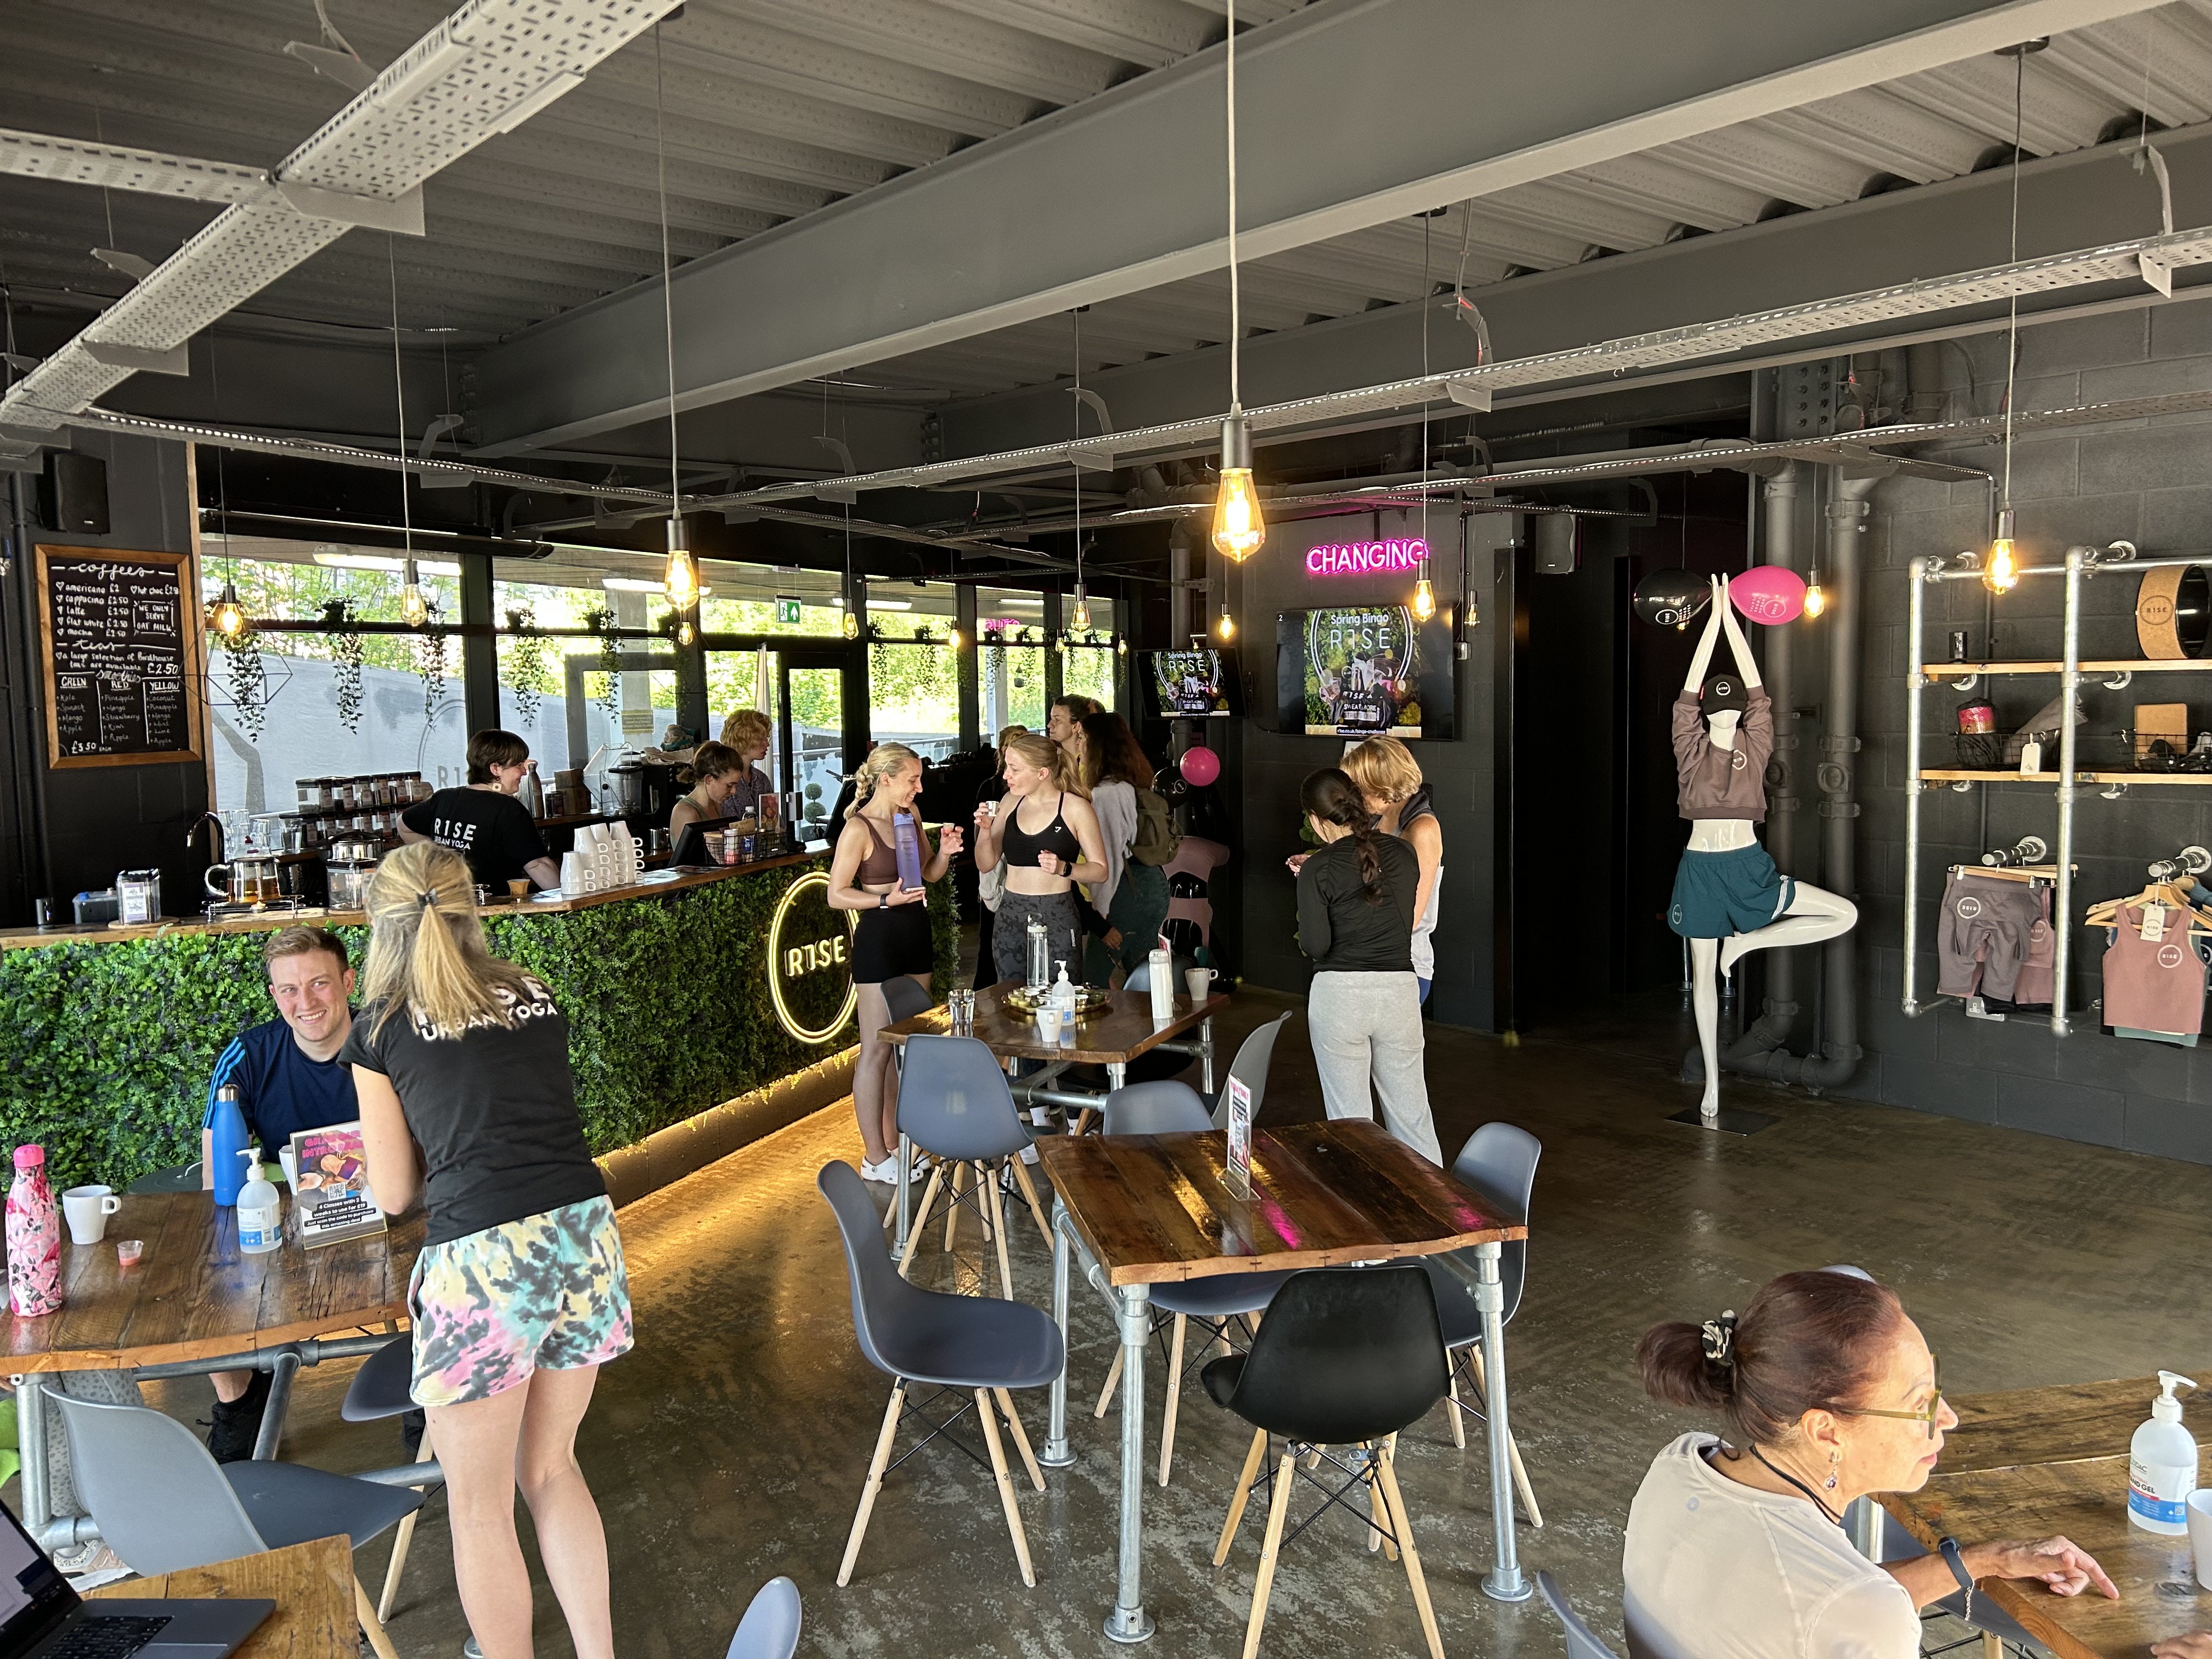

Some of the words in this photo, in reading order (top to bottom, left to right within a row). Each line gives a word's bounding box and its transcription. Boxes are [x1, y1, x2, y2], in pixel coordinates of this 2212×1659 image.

[1307, 539, 1429, 573] CHANGING
[68, 563, 154, 580] coffees
[65, 583, 105, 594] americano
[110, 583, 119, 592] £2
[66, 606, 86, 615] latte
[1331, 613, 1360, 627] Spring
[1362, 613, 1389, 625] Bingo
[153, 623, 172, 631] MILK
[72, 639, 125, 651] teas
[148, 663, 178, 674] £2.50
[61, 676, 86, 687] GREEN
[111, 680, 129, 689] RED
[149, 681, 179, 690] YELLOW
[452, 839, 471, 850] YOGA
[302, 1145, 336, 1158] INTRO
[2141, 1483, 2155, 1494] GEL
